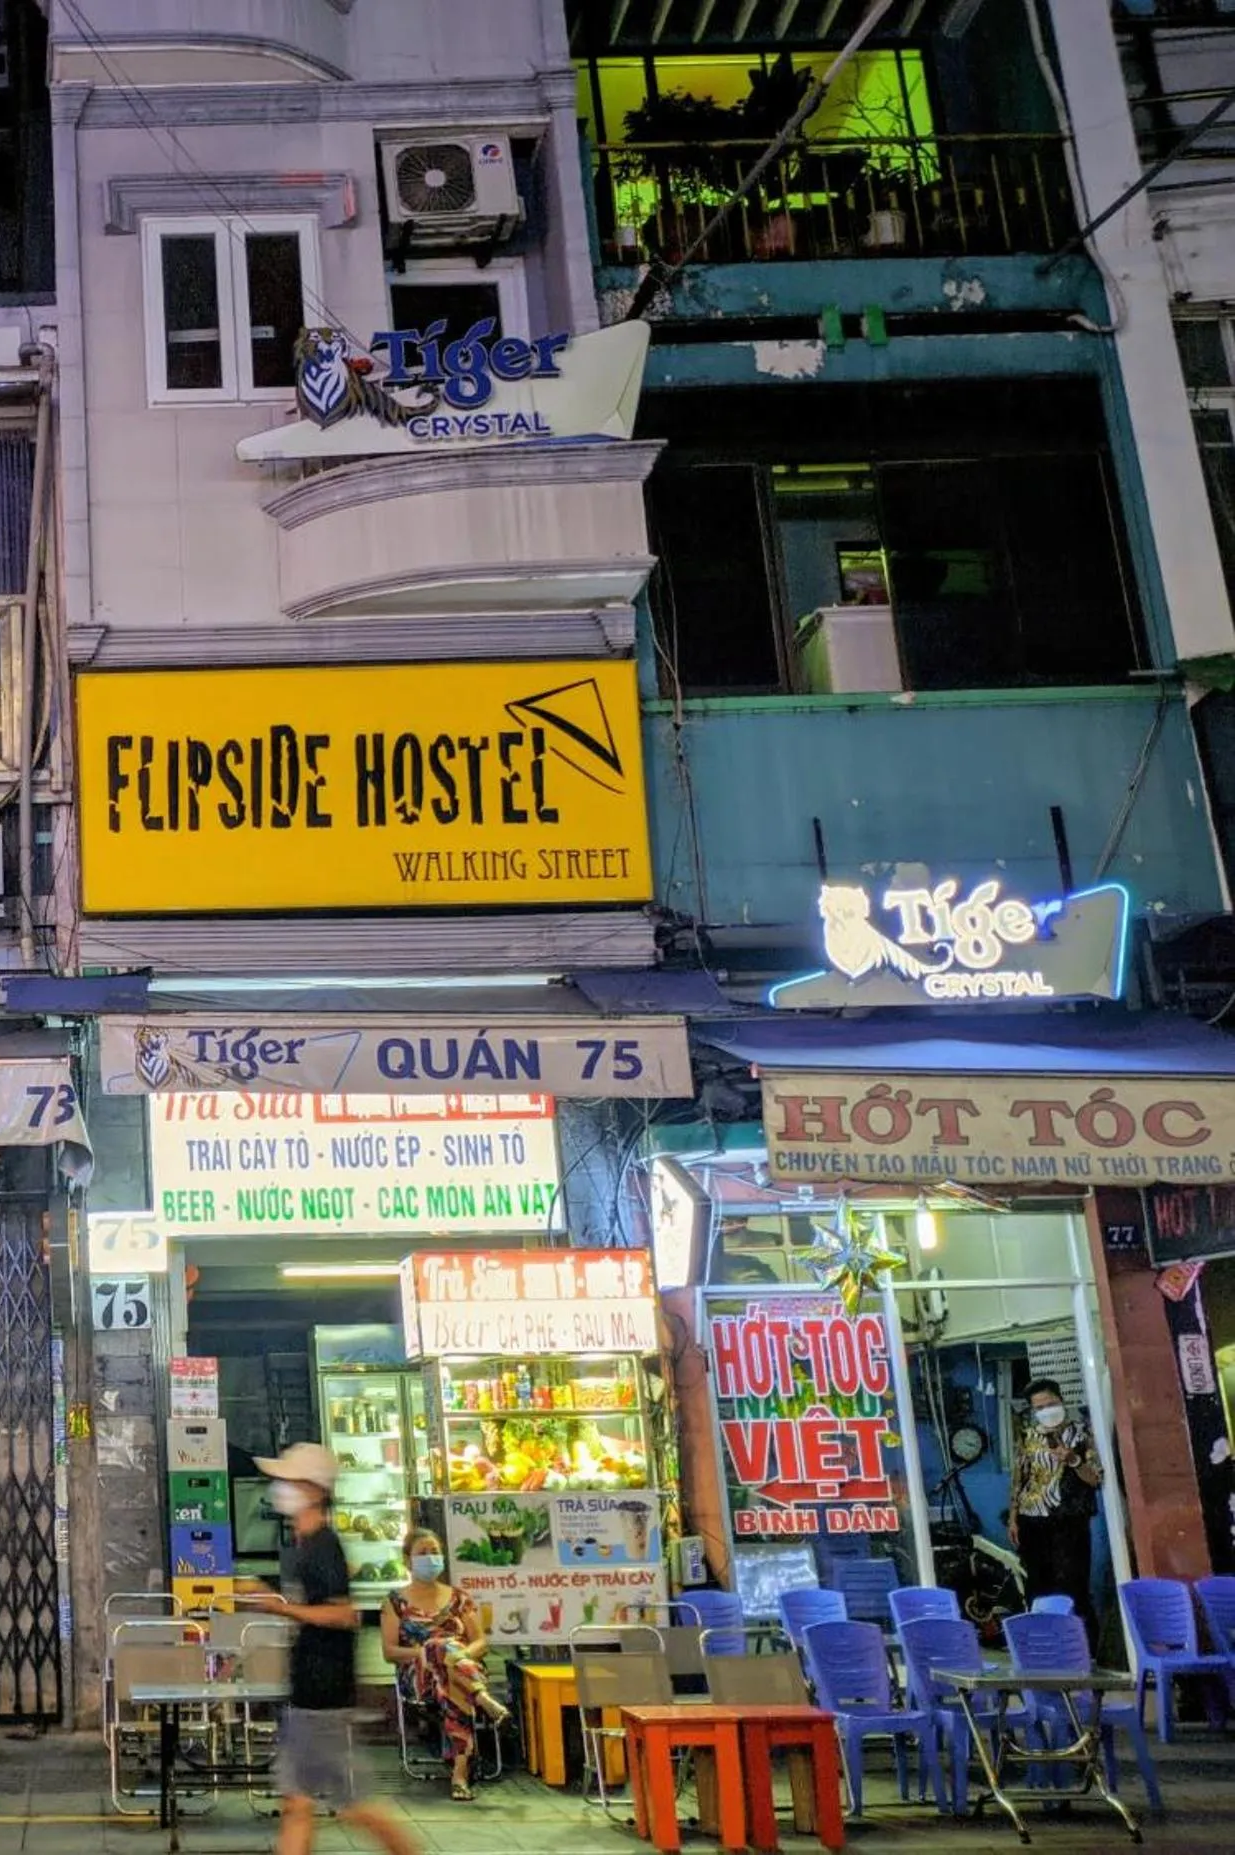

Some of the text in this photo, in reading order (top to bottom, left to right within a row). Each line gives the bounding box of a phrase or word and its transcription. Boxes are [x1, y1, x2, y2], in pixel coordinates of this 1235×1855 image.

[407, 413, 552, 439] CRYSTAL
[107, 725, 559, 833] FLIPSIDE HOSTEL
[393, 847, 631, 883] WALKING STREET
[924, 972, 1054, 998] CRYSTAL
[376, 1028, 542, 1081] QUÁN
[575, 1040, 644, 1081] 75
[25, 1084, 75, 1129] 73
[775, 1083, 1213, 1149] HỚT TÓC
[186, 1132, 231, 1172] TRÁI
[238, 1131, 277, 1170] CÂY
[330, 1129, 389, 1169] NƯỚC
[394, 1128, 421, 1168] ÉP
[443, 1133, 495, 1168] SINH
[774, 1148, 859, 1174] CHUYÊN
[965, 1150, 1007, 1176] TÓC
[1011, 1155, 1058, 1177] NAM
[1063, 1151, 1093, 1177] NỮ
[1152, 1155, 1224, 1176] TRANG
[161, 1189, 216, 1222] BEER
[236, 1180, 295, 1221] NƯỚC
[377, 1178, 420, 1220] CÁC
[425, 1177, 477, 1218] MÓN
[95, 1218, 160, 1250] 75
[1107, 1225, 1135, 1242] 77
[95, 1281, 149, 1330] 75
[710, 1300, 890, 1399] HỚT TÓC
[720, 1403, 890, 1497] VIỆT
[451, 1500, 488, 1517] RAU
[734, 1503, 900, 1535] BÌNH DÂN
[460, 1575, 496, 1590] SINH
